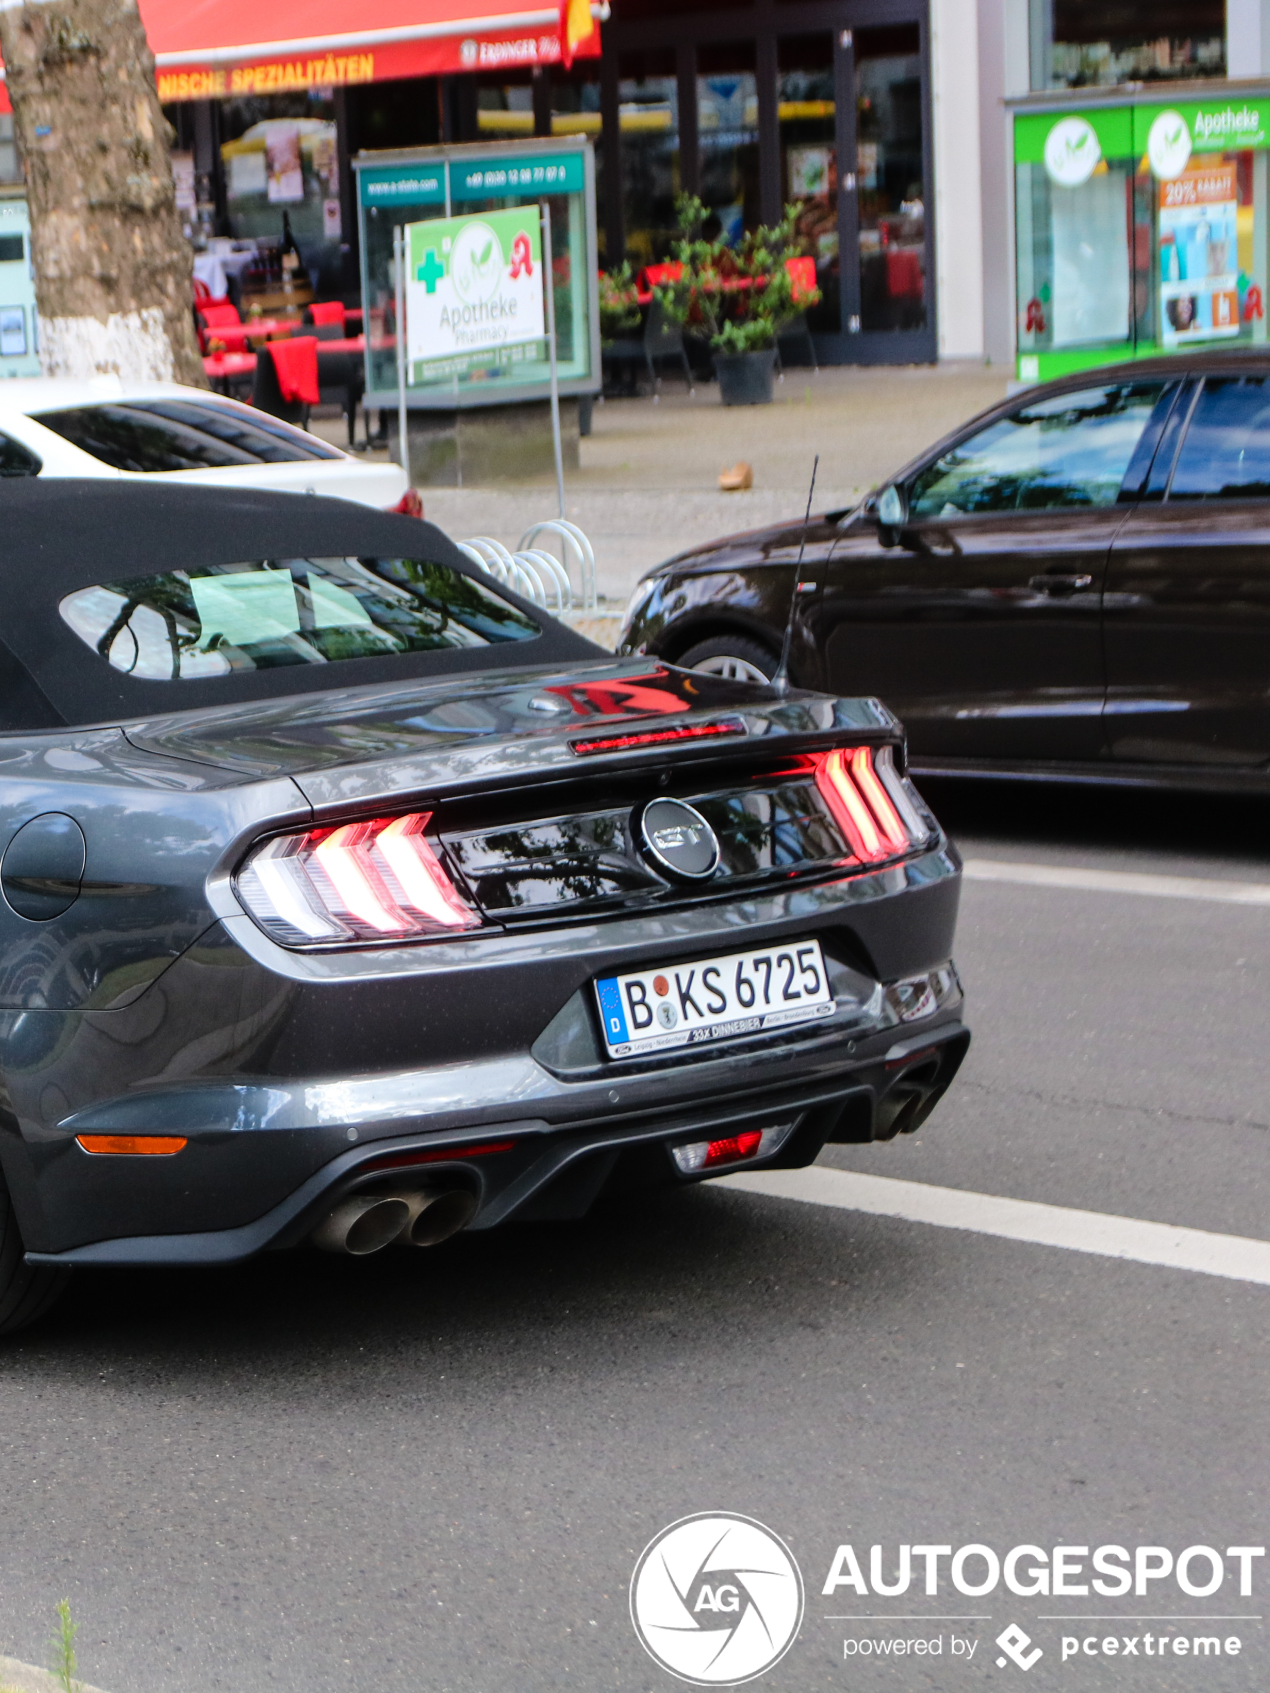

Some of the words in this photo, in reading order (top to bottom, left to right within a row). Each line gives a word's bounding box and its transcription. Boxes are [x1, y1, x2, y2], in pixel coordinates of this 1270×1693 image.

[479, 39, 537, 64] ERDINGER
[231, 52, 374, 95] SPEZIALITÄTEN
[1194, 105, 1260, 139] Apotheke
[533, 166, 544, 183] 77
[1165, 181, 1196, 205] 20%
[1197, 176, 1231, 194] RABATT
[439, 294, 518, 334] Apotheke
[455, 323, 509, 347] Pharmacy
[653, 823, 705, 850] GT
[625, 980, 653, 1030] B
[675, 966, 727, 1021] KS
[735, 948, 821, 1008] 6725
[610, 1018, 621, 1033] D
[712, 1018, 761, 1038] DINNEBIER
